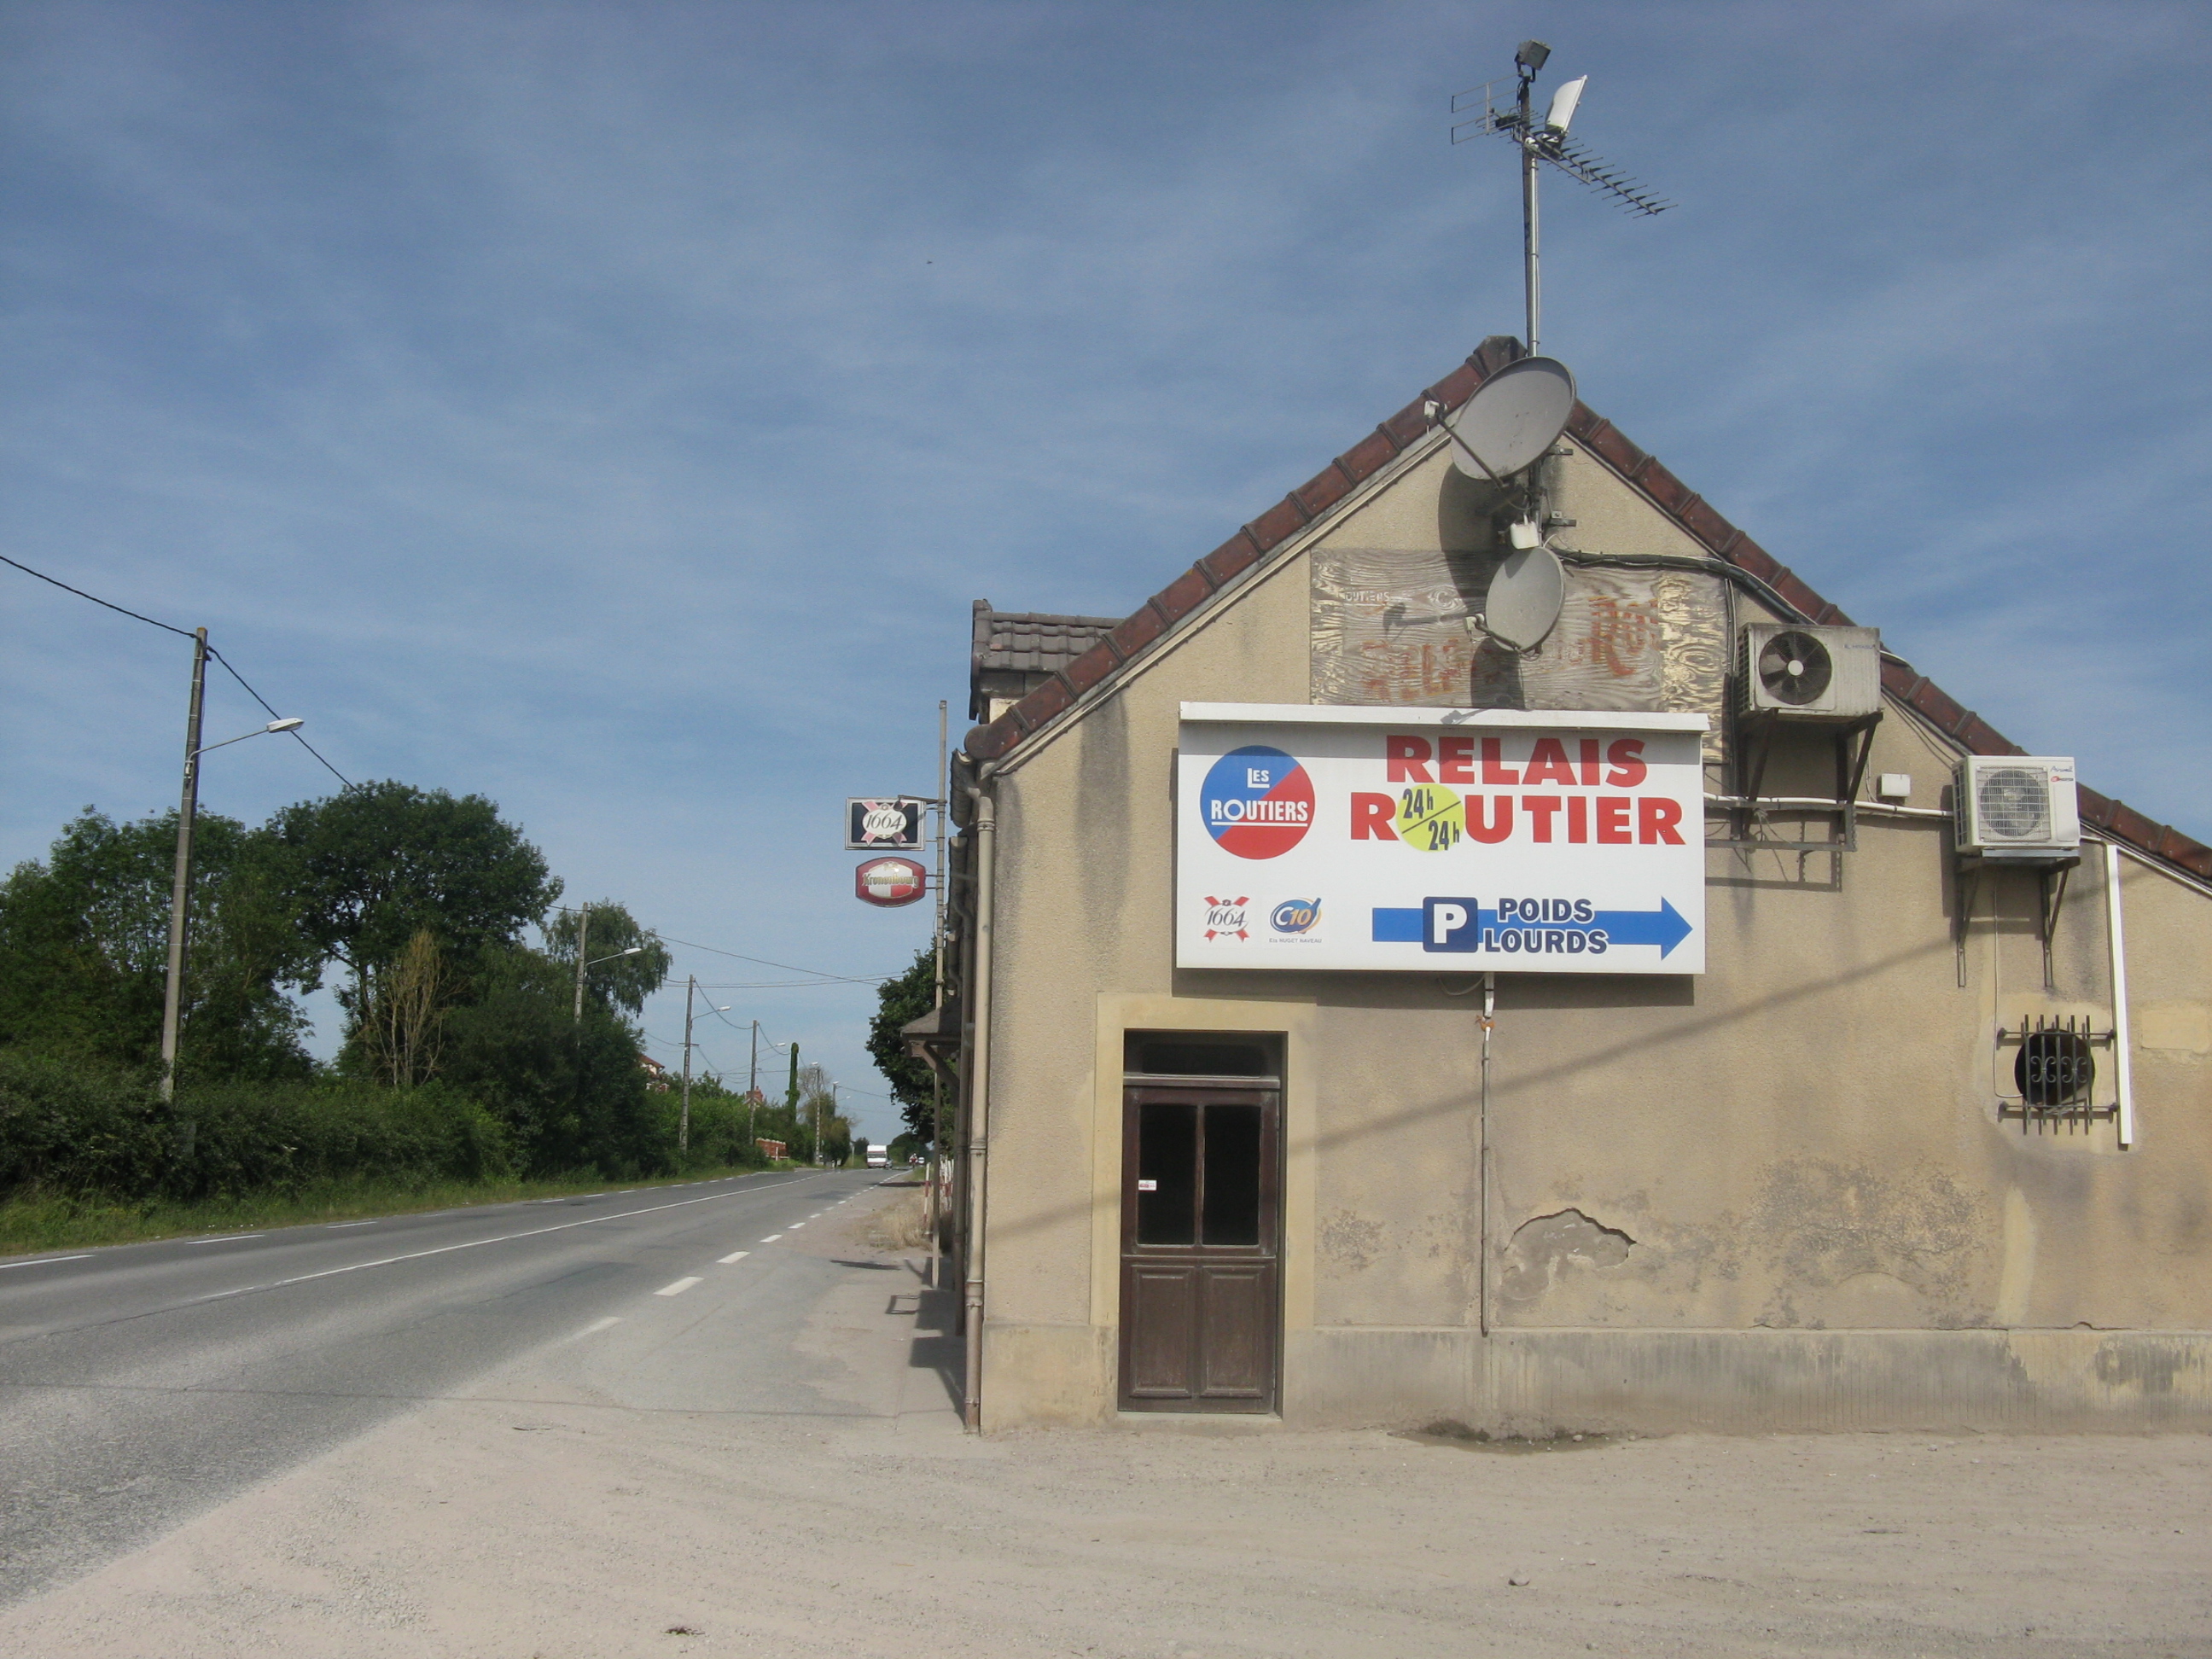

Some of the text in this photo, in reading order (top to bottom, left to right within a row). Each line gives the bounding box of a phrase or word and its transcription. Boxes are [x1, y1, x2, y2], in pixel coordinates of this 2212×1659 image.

[1386, 735, 1648, 788] RELAIS
[1247, 767, 1270, 789] LES
[865, 813, 904, 830] 1664
[1210, 799, 1308, 822] ROUTIERS
[1206, 907, 1247, 928] 1664
[1275, 905, 1313, 926] C10
[1433, 898, 1593, 944] P POIDS
[1484, 929, 1608, 954] LOURDS
